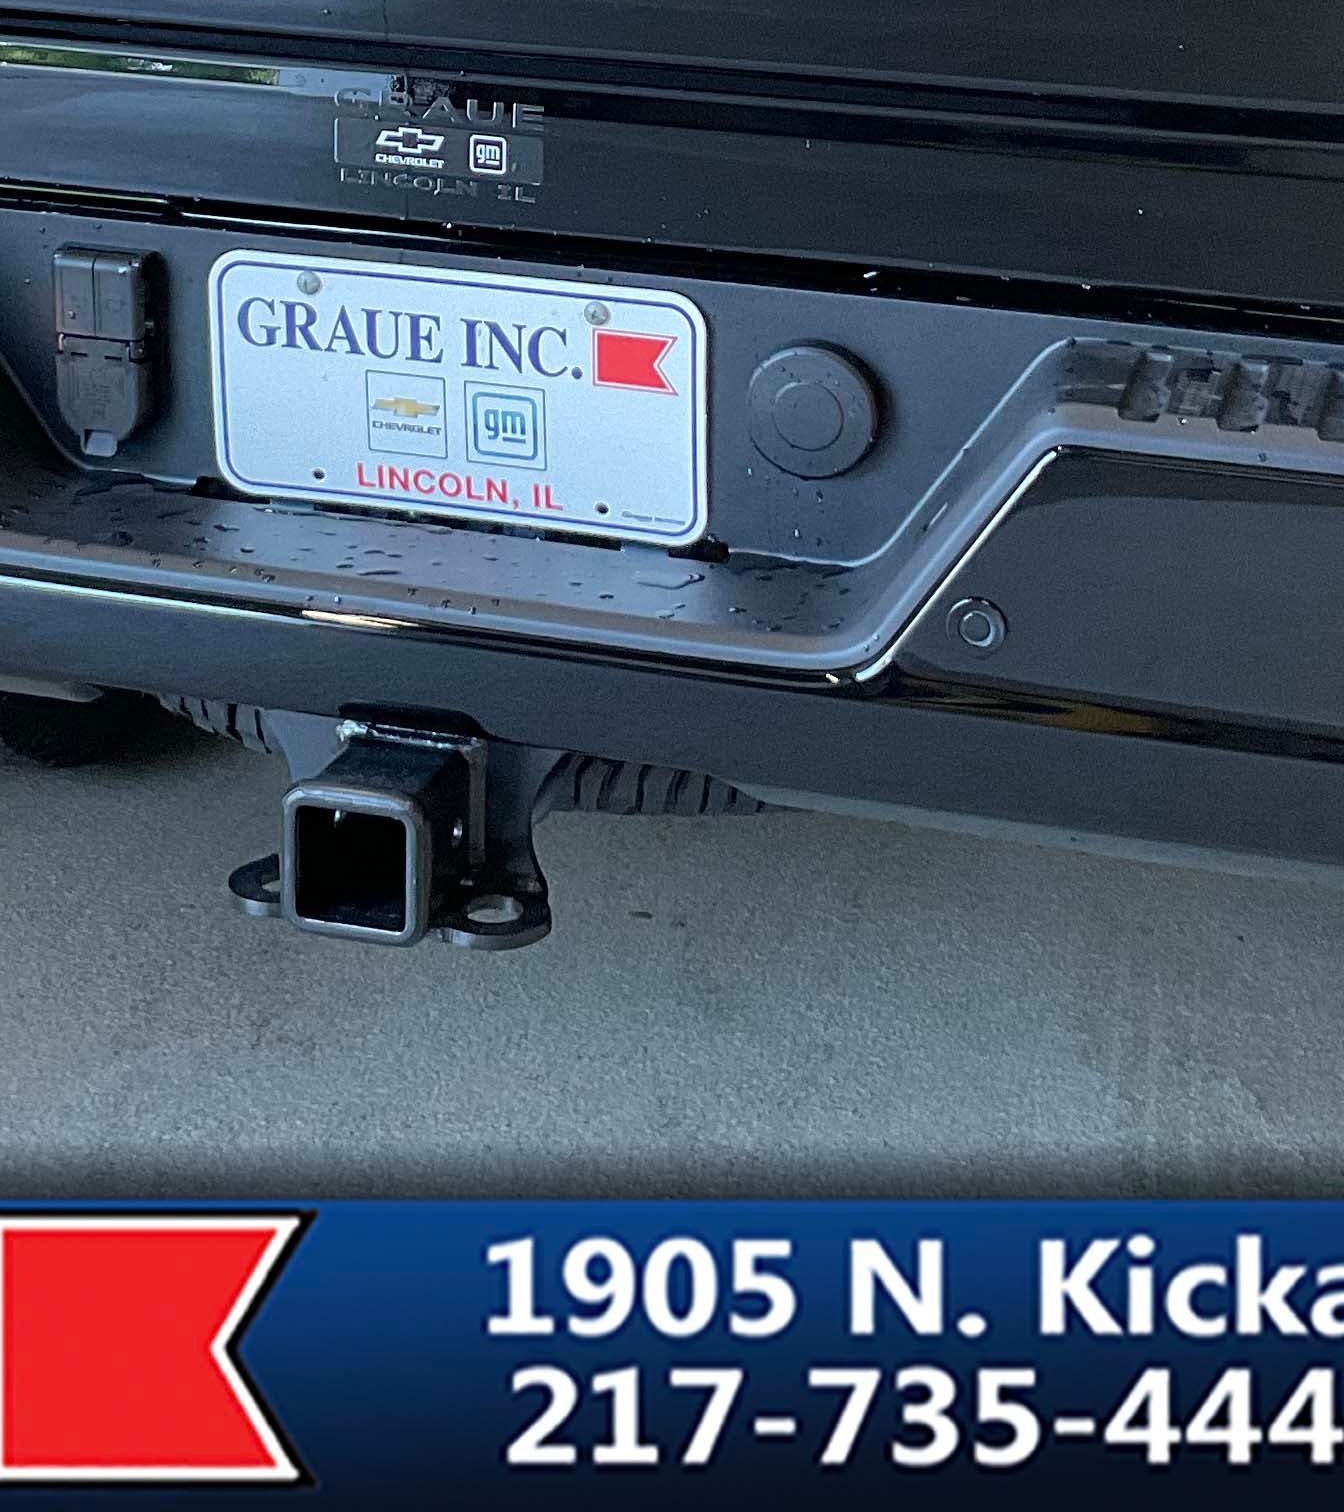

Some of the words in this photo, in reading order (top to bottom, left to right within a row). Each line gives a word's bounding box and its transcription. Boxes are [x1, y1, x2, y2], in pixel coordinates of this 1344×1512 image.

[375, 152, 445, 169] CHEVROLET
[237, 296, 444, 364] GRAUE
[460, 317, 584, 380] INC.
[372, 420, 442, 436] CHEVROLET
[357, 462, 520, 510] LINCOLN,
[534, 483, 564, 511] IL
